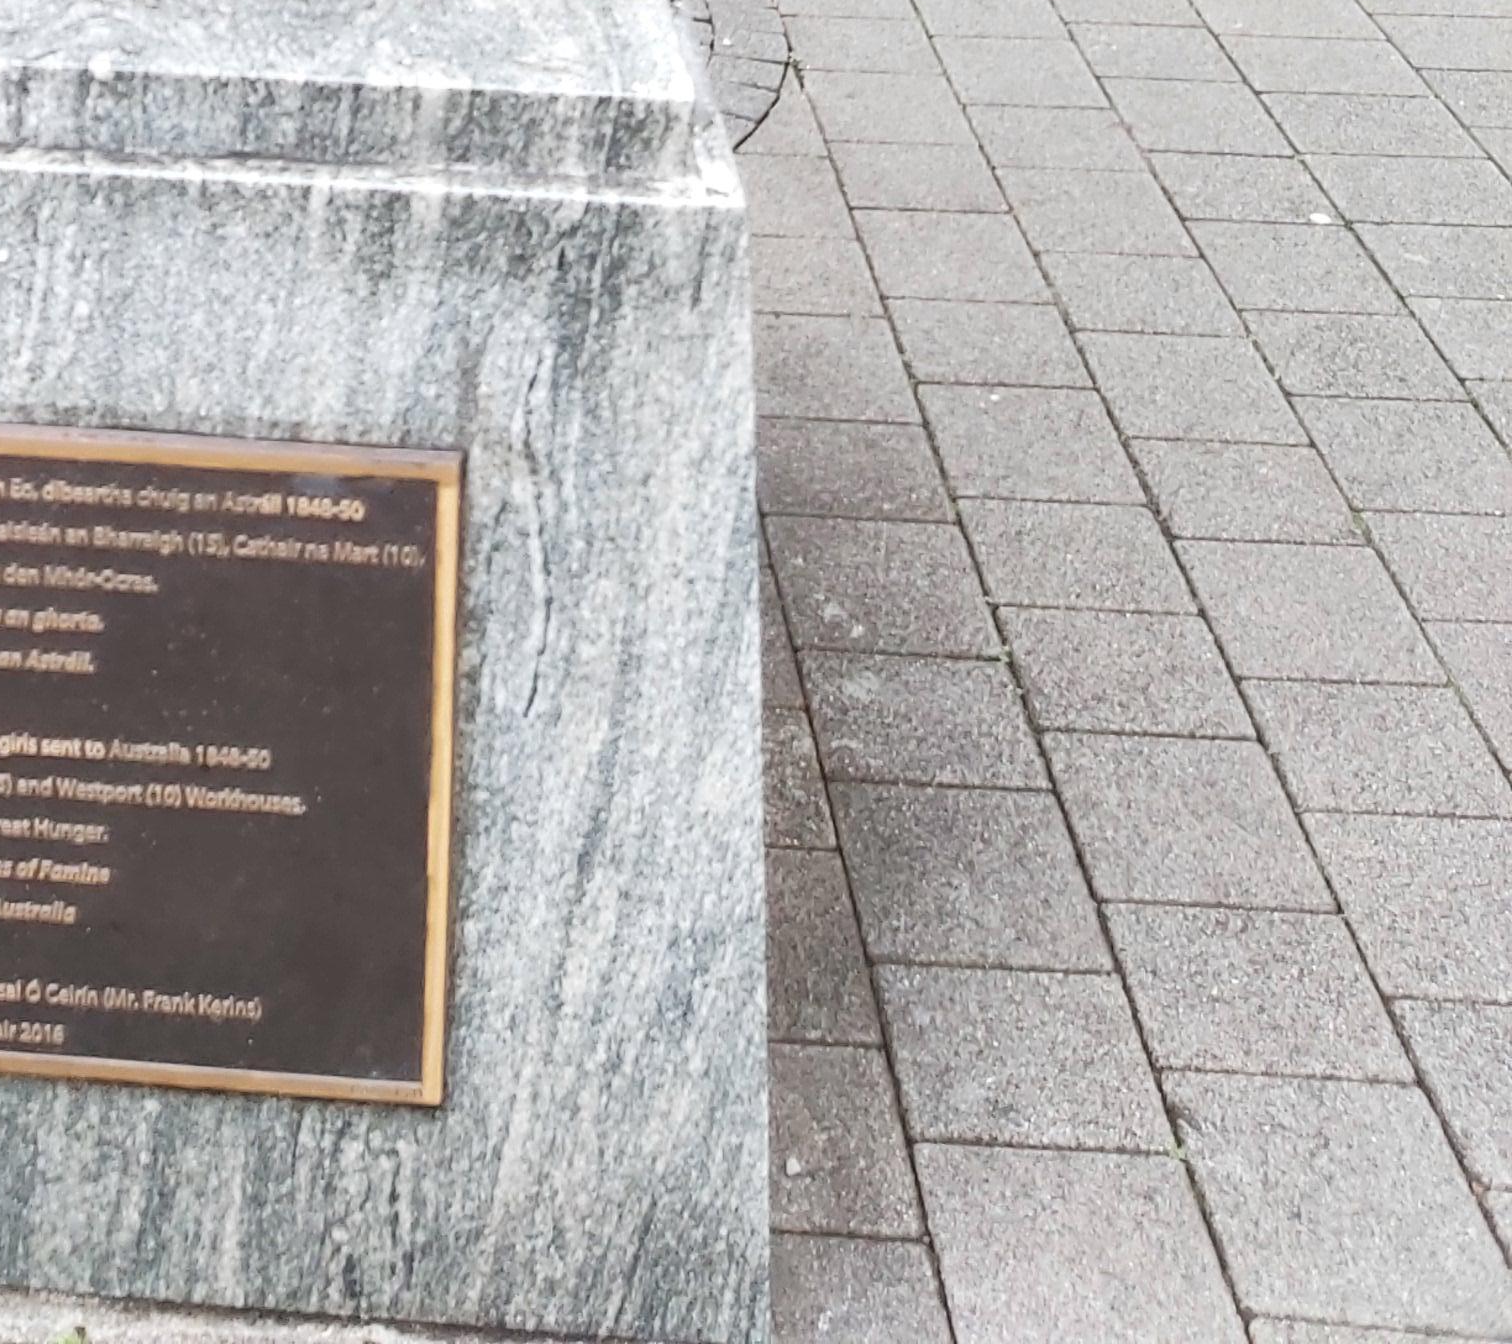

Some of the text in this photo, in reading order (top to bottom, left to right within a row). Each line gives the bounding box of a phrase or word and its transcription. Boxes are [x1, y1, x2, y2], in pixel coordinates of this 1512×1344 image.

[139, 486, 190, 512] chuig
[195, 493, 218, 509] an
[65, 528, 89, 544] an
[233, 535, 301, 557] Cathair
[304, 544, 330, 559] na
[334, 542, 380, 562] Mart
[3, 563, 40, 584] den
[4, 609, 30, 626] an
[41, 738, 82, 757] sent
[85, 740, 106, 759] to
[110, 739, 192, 763] Australia
[196, 746, 272, 768] 1848-50
[17, 776, 55, 795] and
[56, 778, 143, 802] Westport
[146, 784, 182, 806] (10)
[16, 858, 40, 878] of
[39, 860, 111, 883] Famine
[104, 987, 139, 1008] (Mr.
[143, 990, 196, 1012] Frank
[199, 994, 263, 1018] Kerins)
